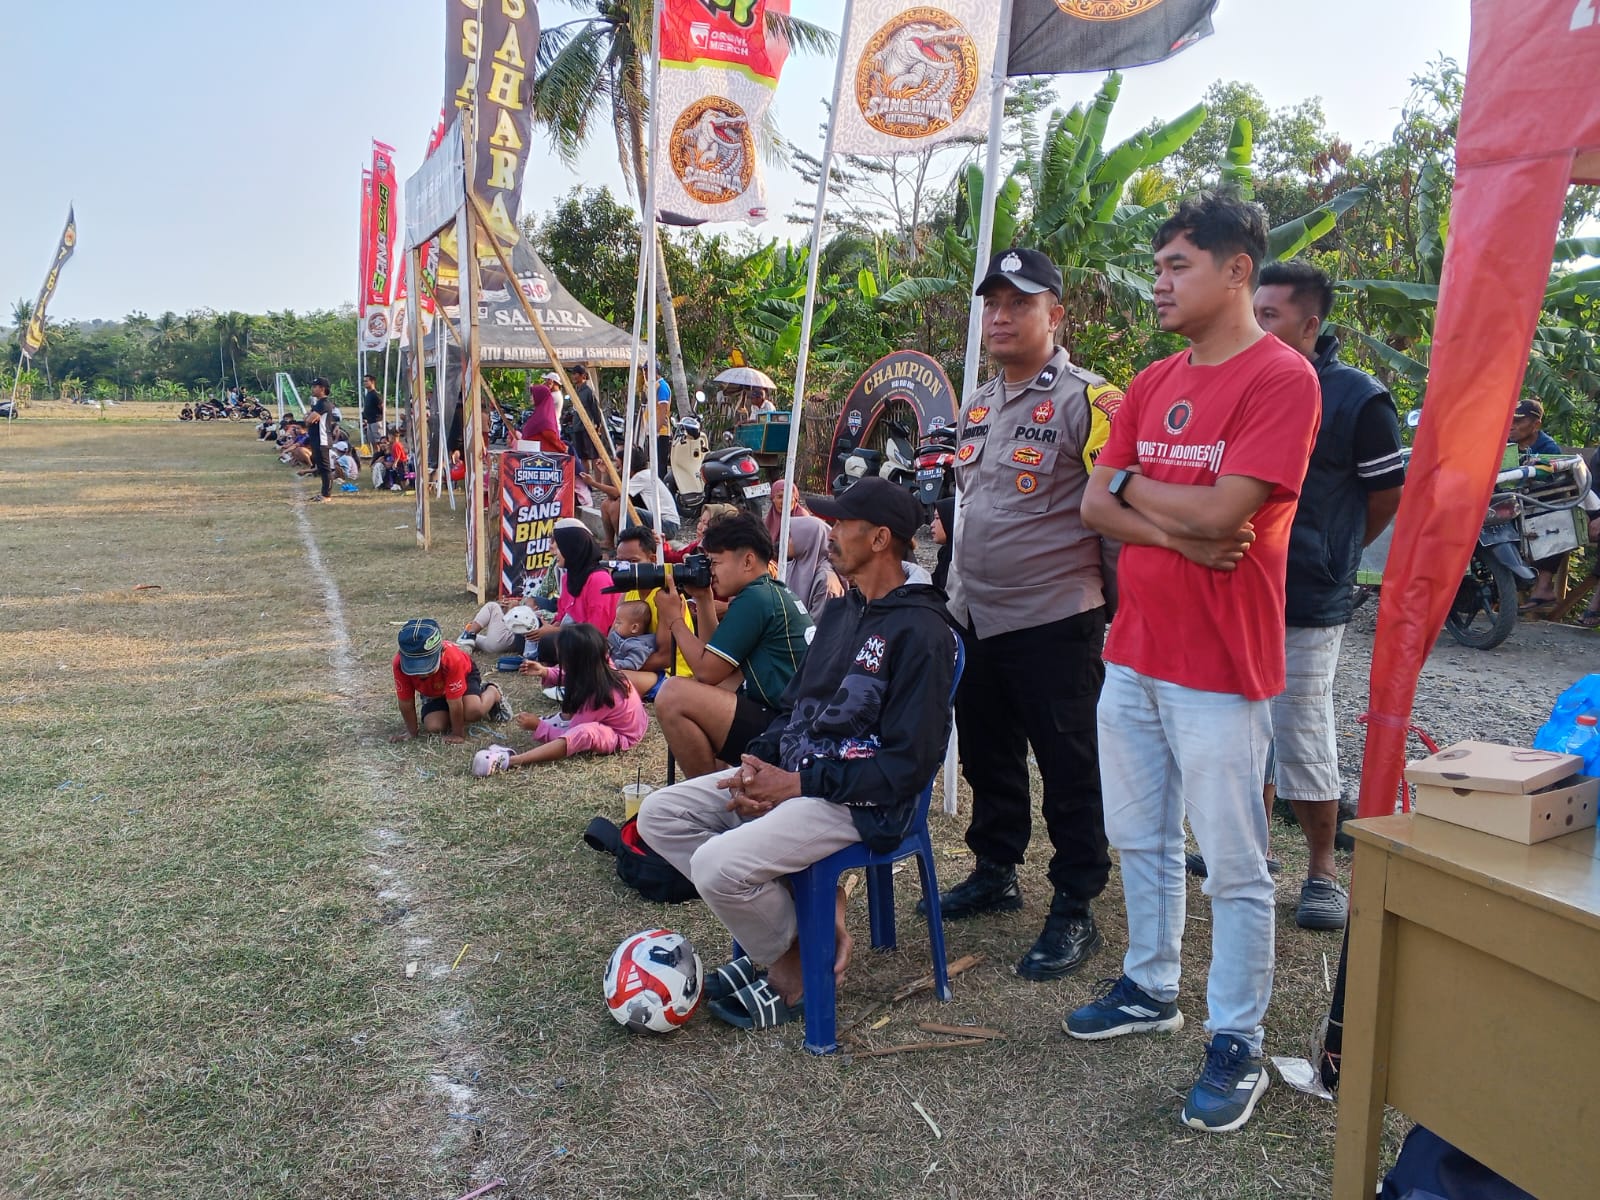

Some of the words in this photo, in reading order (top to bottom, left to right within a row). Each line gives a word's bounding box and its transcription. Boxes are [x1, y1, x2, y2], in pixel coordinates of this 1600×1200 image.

[709, 41, 749, 56] MERCH
[480, 346, 501, 361] ATU
[557, 348, 584, 361] ENUH
[863, 361, 943, 398] CHAMPION
[1014, 425, 1058, 444] POLRI
[517, 470, 539, 482] SANG
[539, 471, 560, 483] BIMA
[518, 502, 561, 522] SANG
[515, 519, 562, 542] BIM
[526, 554, 554, 570] U15
